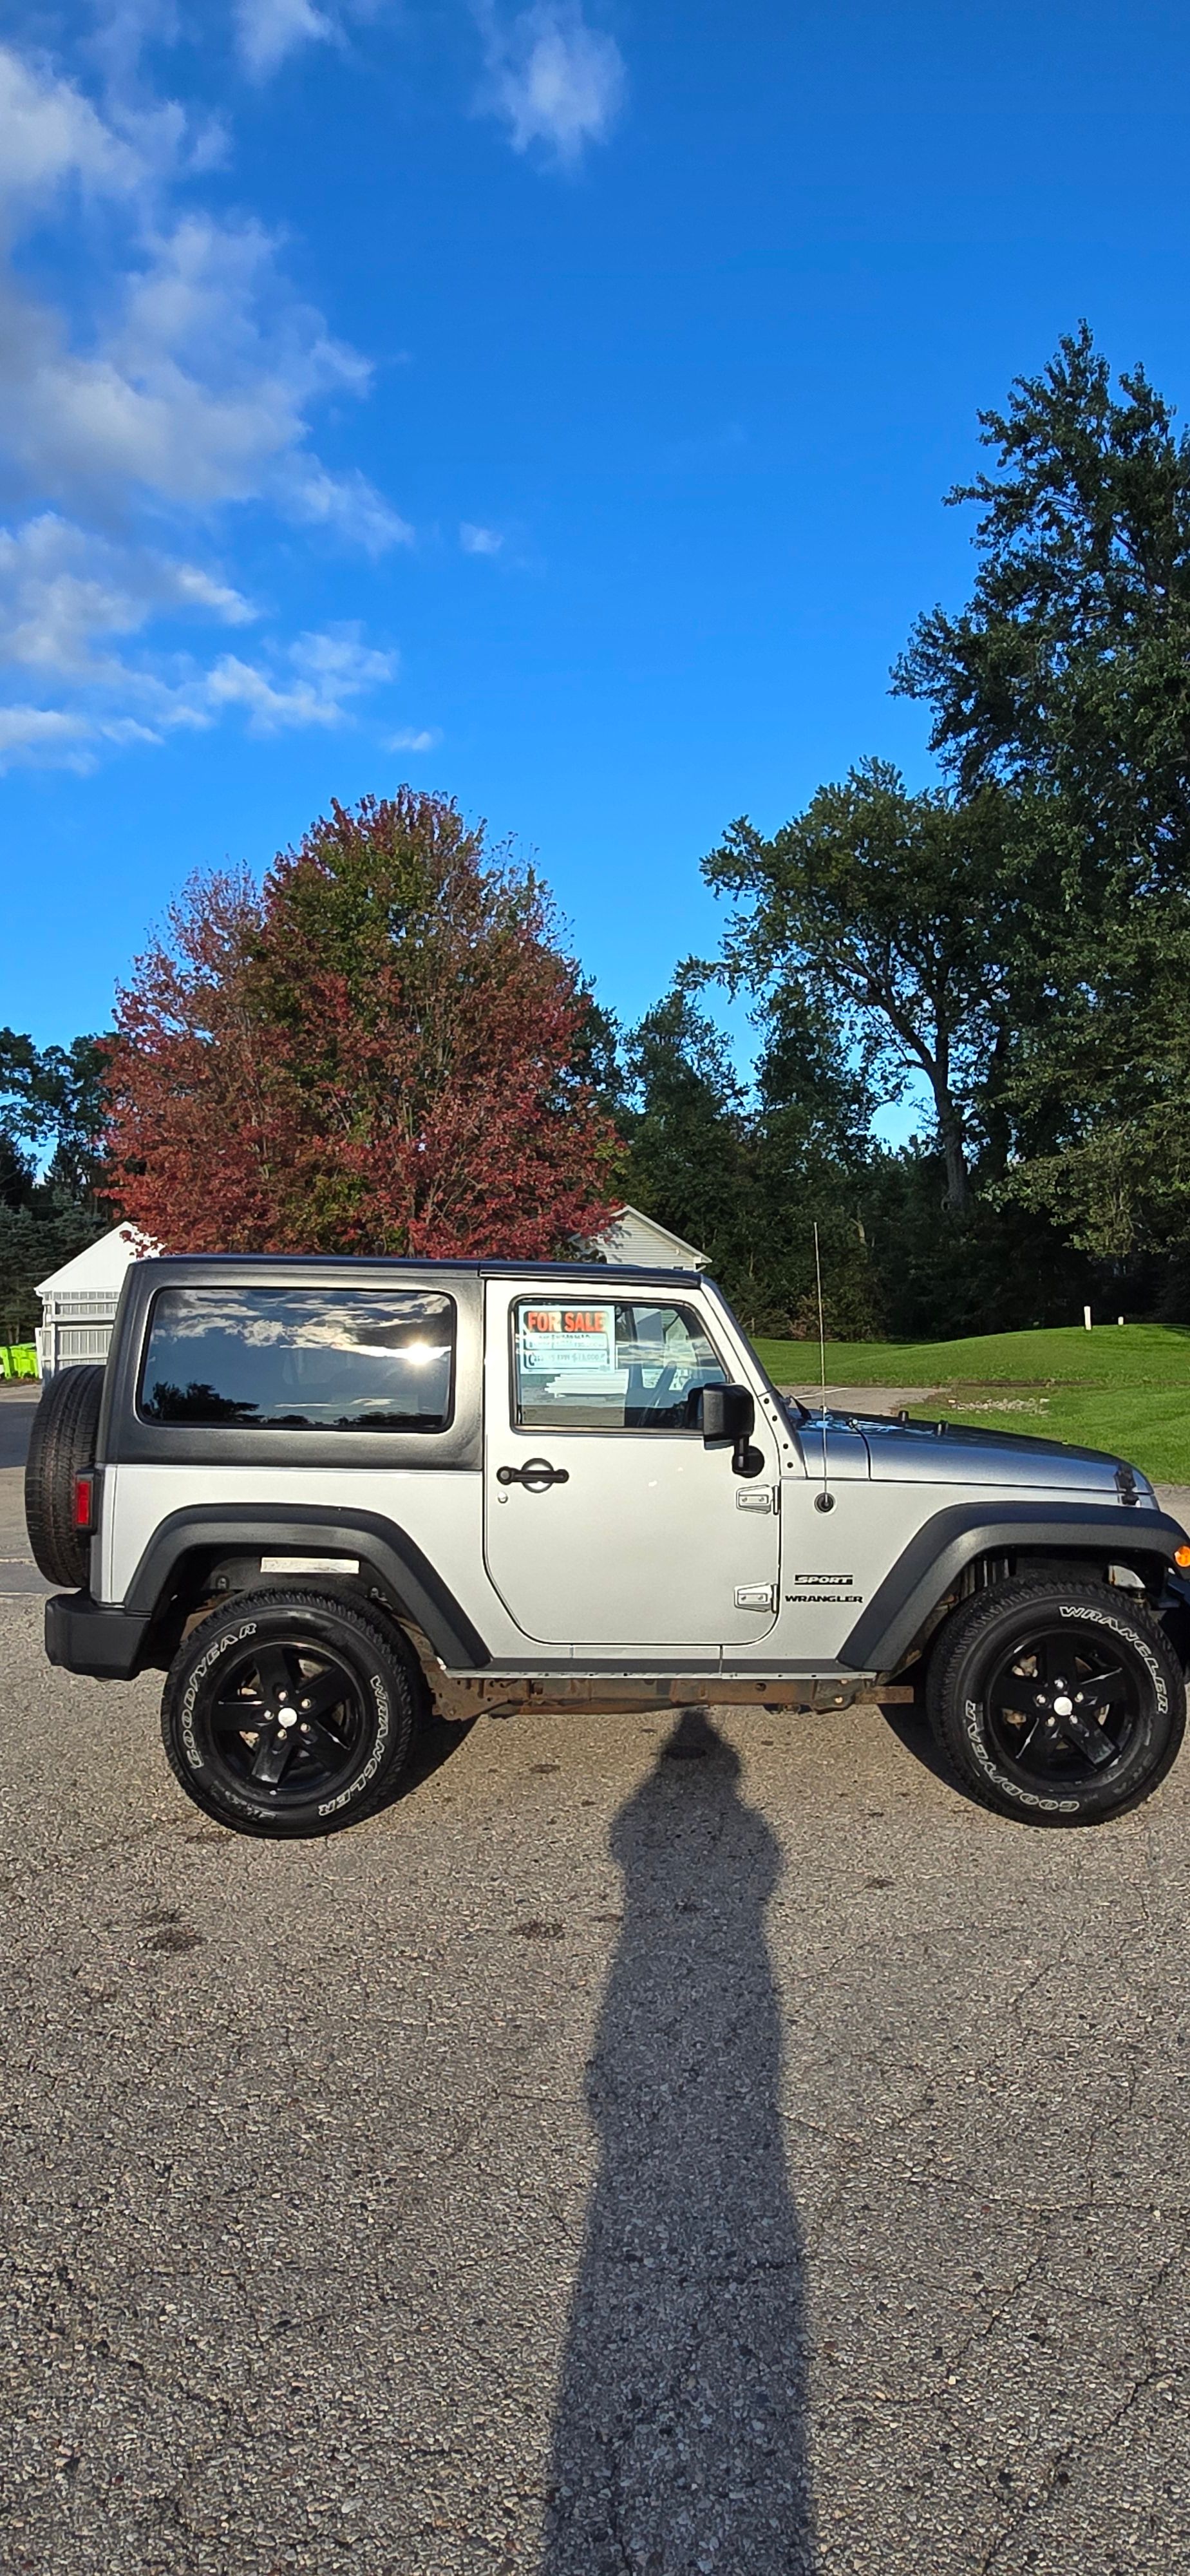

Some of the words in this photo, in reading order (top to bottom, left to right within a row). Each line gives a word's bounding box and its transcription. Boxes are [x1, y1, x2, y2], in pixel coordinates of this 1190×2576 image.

[527, 1312, 562, 1332] FOR
[564, 1312, 605, 1332] SALE
[795, 1575, 853, 1584] SPORT
[182, 1622, 257, 1769] GOODYEAR
[1059, 1605, 1168, 1714] WRANGLER
[318, 1675, 388, 1816] WRANGLER
[965, 1700, 1080, 1812] GOODYEAR
